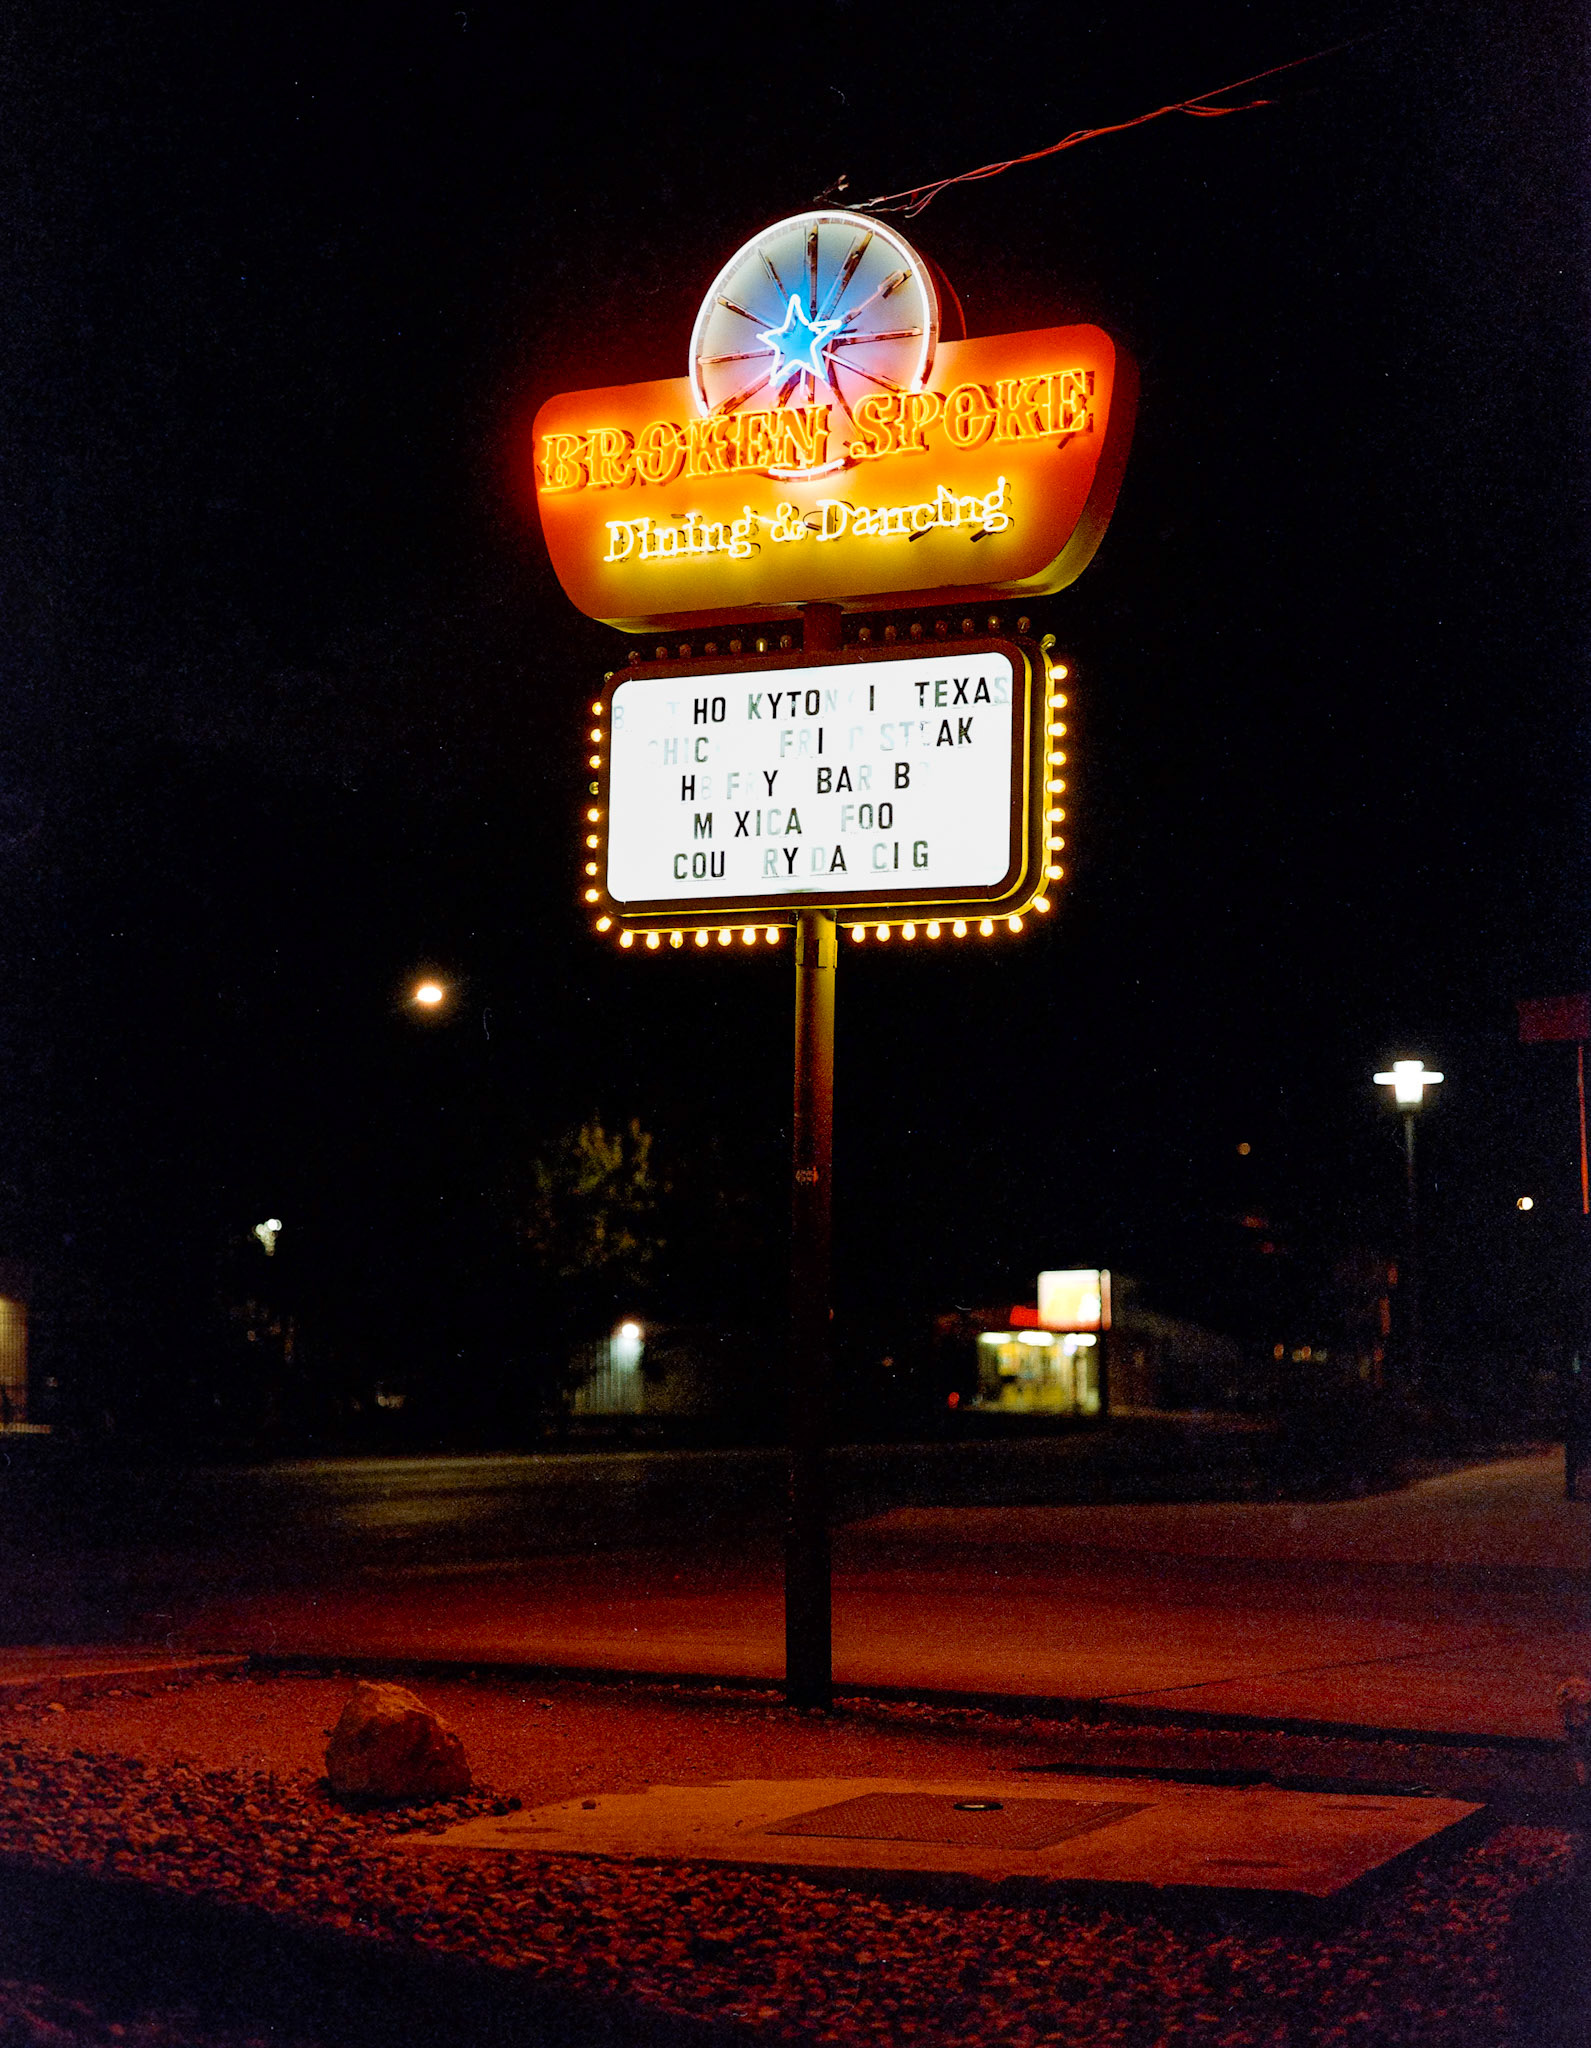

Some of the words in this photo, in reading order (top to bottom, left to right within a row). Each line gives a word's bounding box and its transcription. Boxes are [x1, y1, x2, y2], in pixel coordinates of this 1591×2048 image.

[540, 404, 832, 494] BROKEN
[849, 368, 1088, 460] SPOKE
[603, 506, 758, 562] Dining
[769, 502, 808, 541] &
[816, 475, 1010, 541] Dancing
